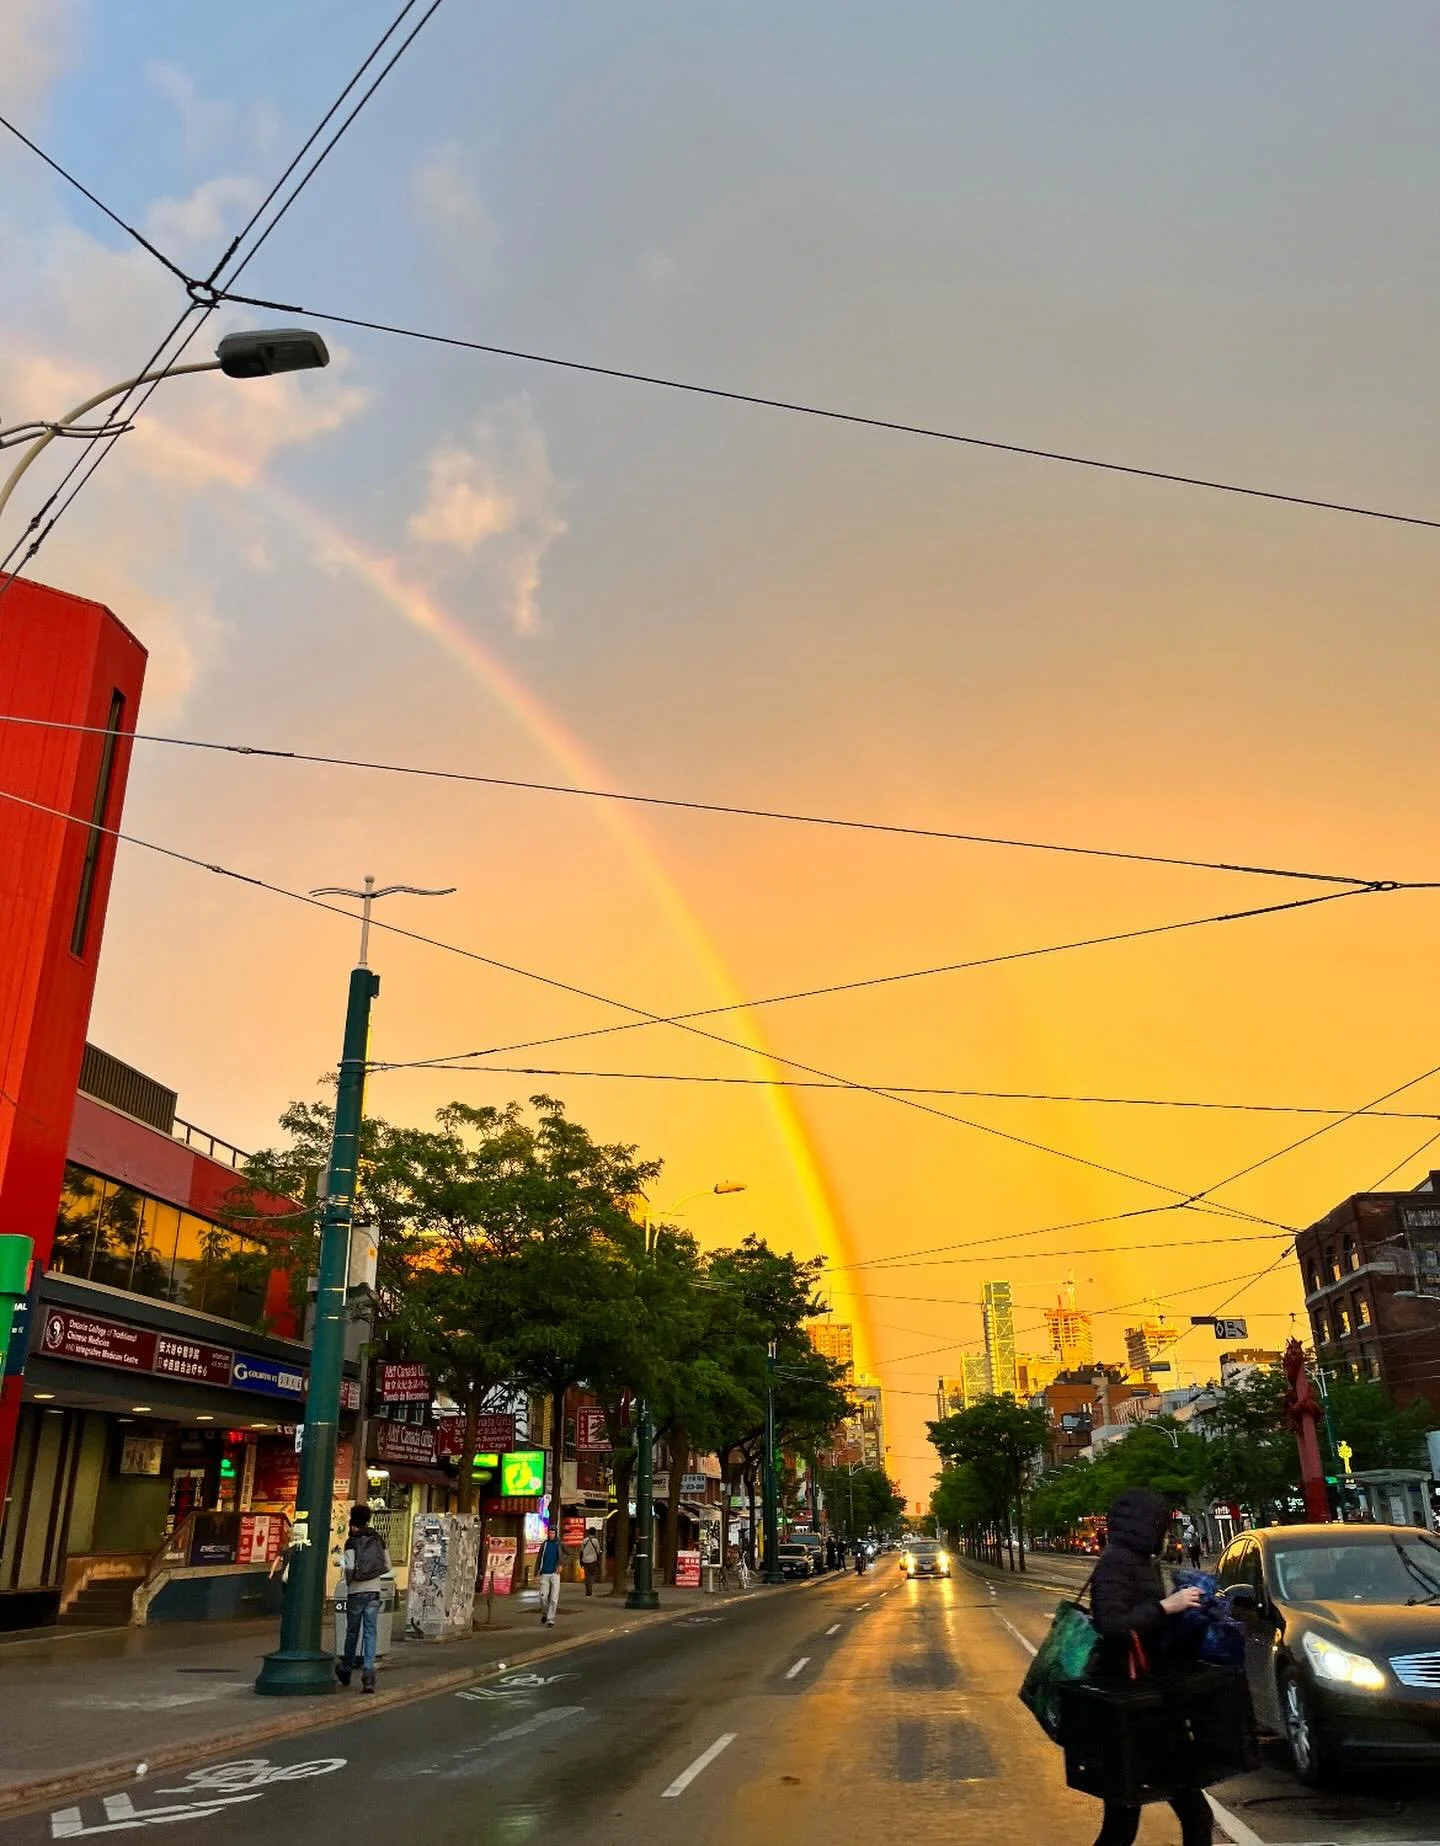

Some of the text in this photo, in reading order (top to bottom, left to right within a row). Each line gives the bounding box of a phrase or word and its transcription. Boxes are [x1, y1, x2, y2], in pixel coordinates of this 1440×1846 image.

[69, 1319, 88, 1331] Ontario
[88, 1324, 106, 1336] College
[113, 1329, 137, 1342] Traditional
[67, 1331, 110, 1347] Chinese Medicine
[102, 1349, 123, 1361] Medicine
[123, 1353, 139, 1364] Centre
[396, 1364, 417, 1378] Canada
[401, 1426, 420, 1446] Canada
